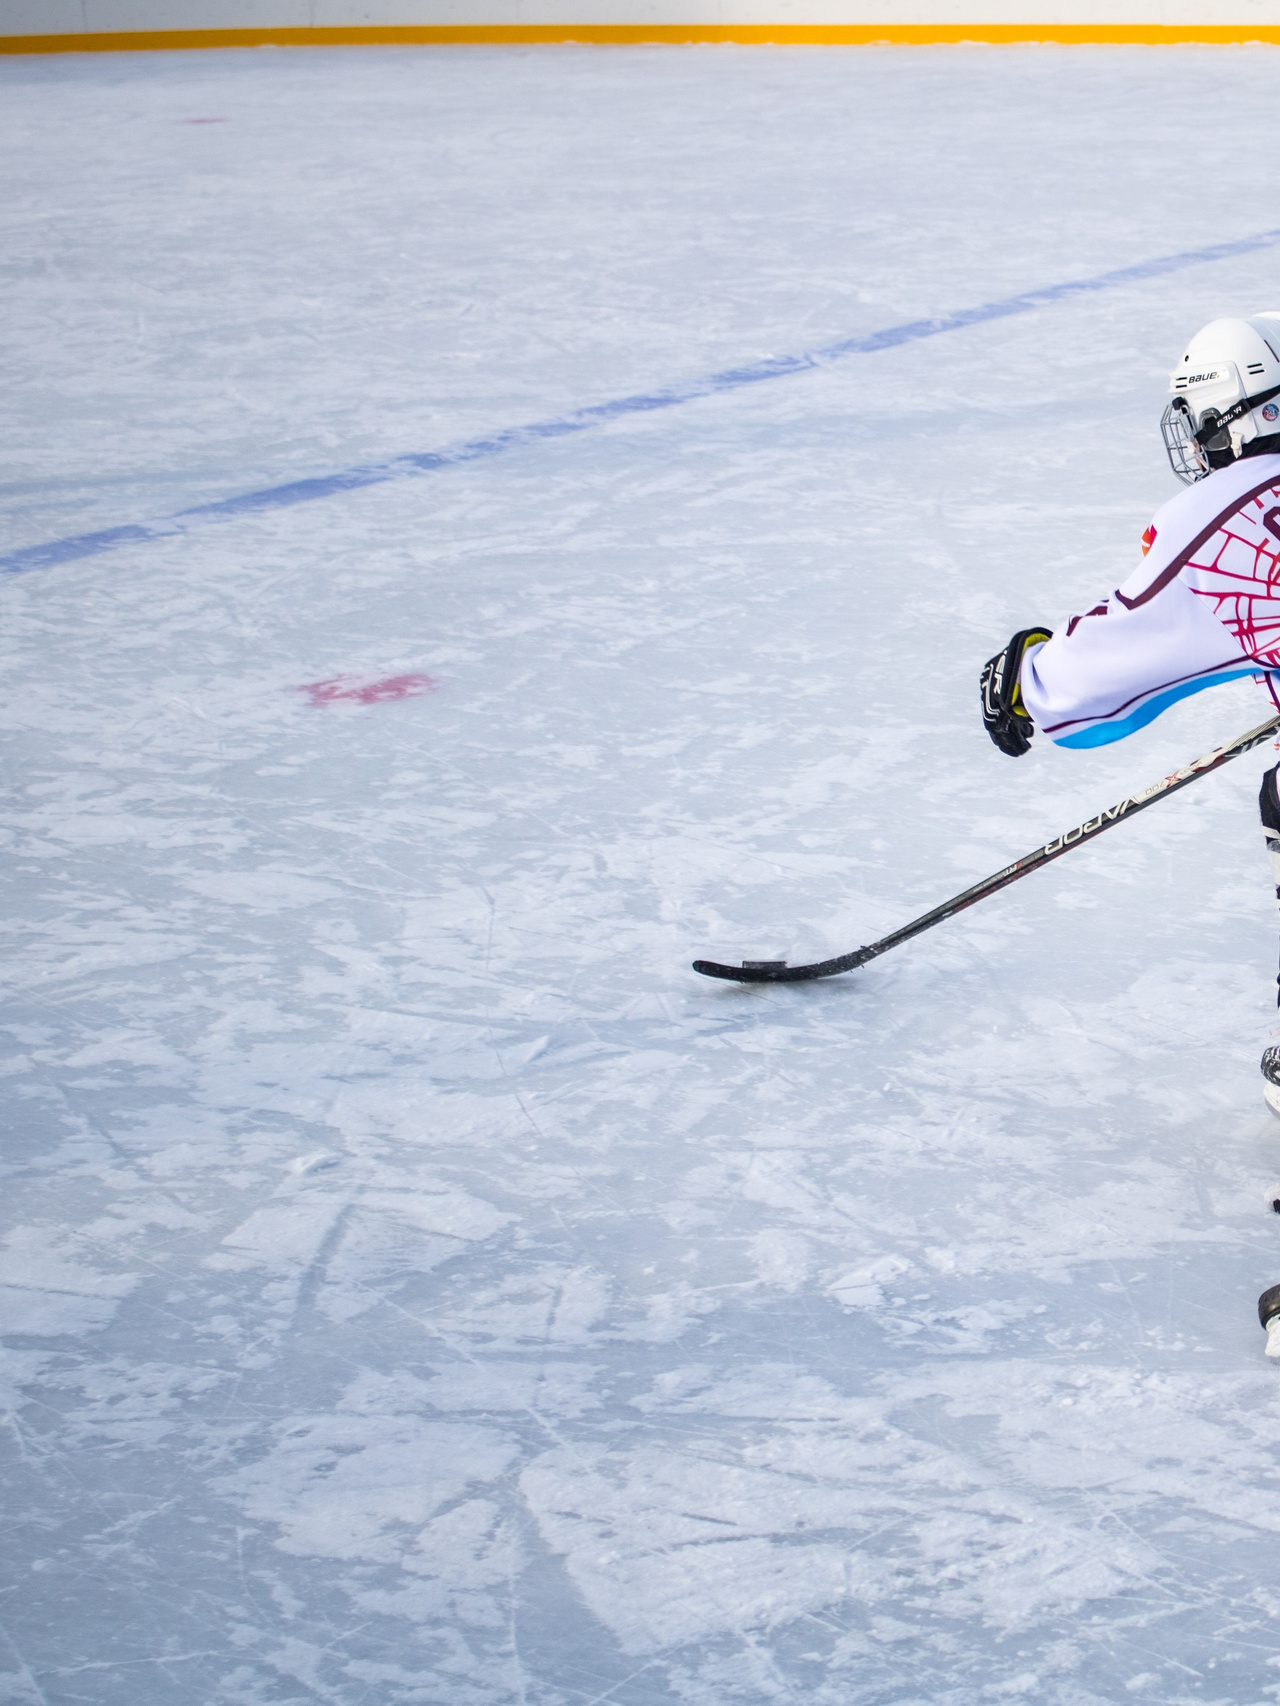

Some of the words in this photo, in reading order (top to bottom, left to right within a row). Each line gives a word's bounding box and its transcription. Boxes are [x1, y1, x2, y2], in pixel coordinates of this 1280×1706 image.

[1188, 370, 1226, 384] BAUE
[1216, 405, 1242, 428] BAUR
[1044, 796, 1140, 856] VAPOR
